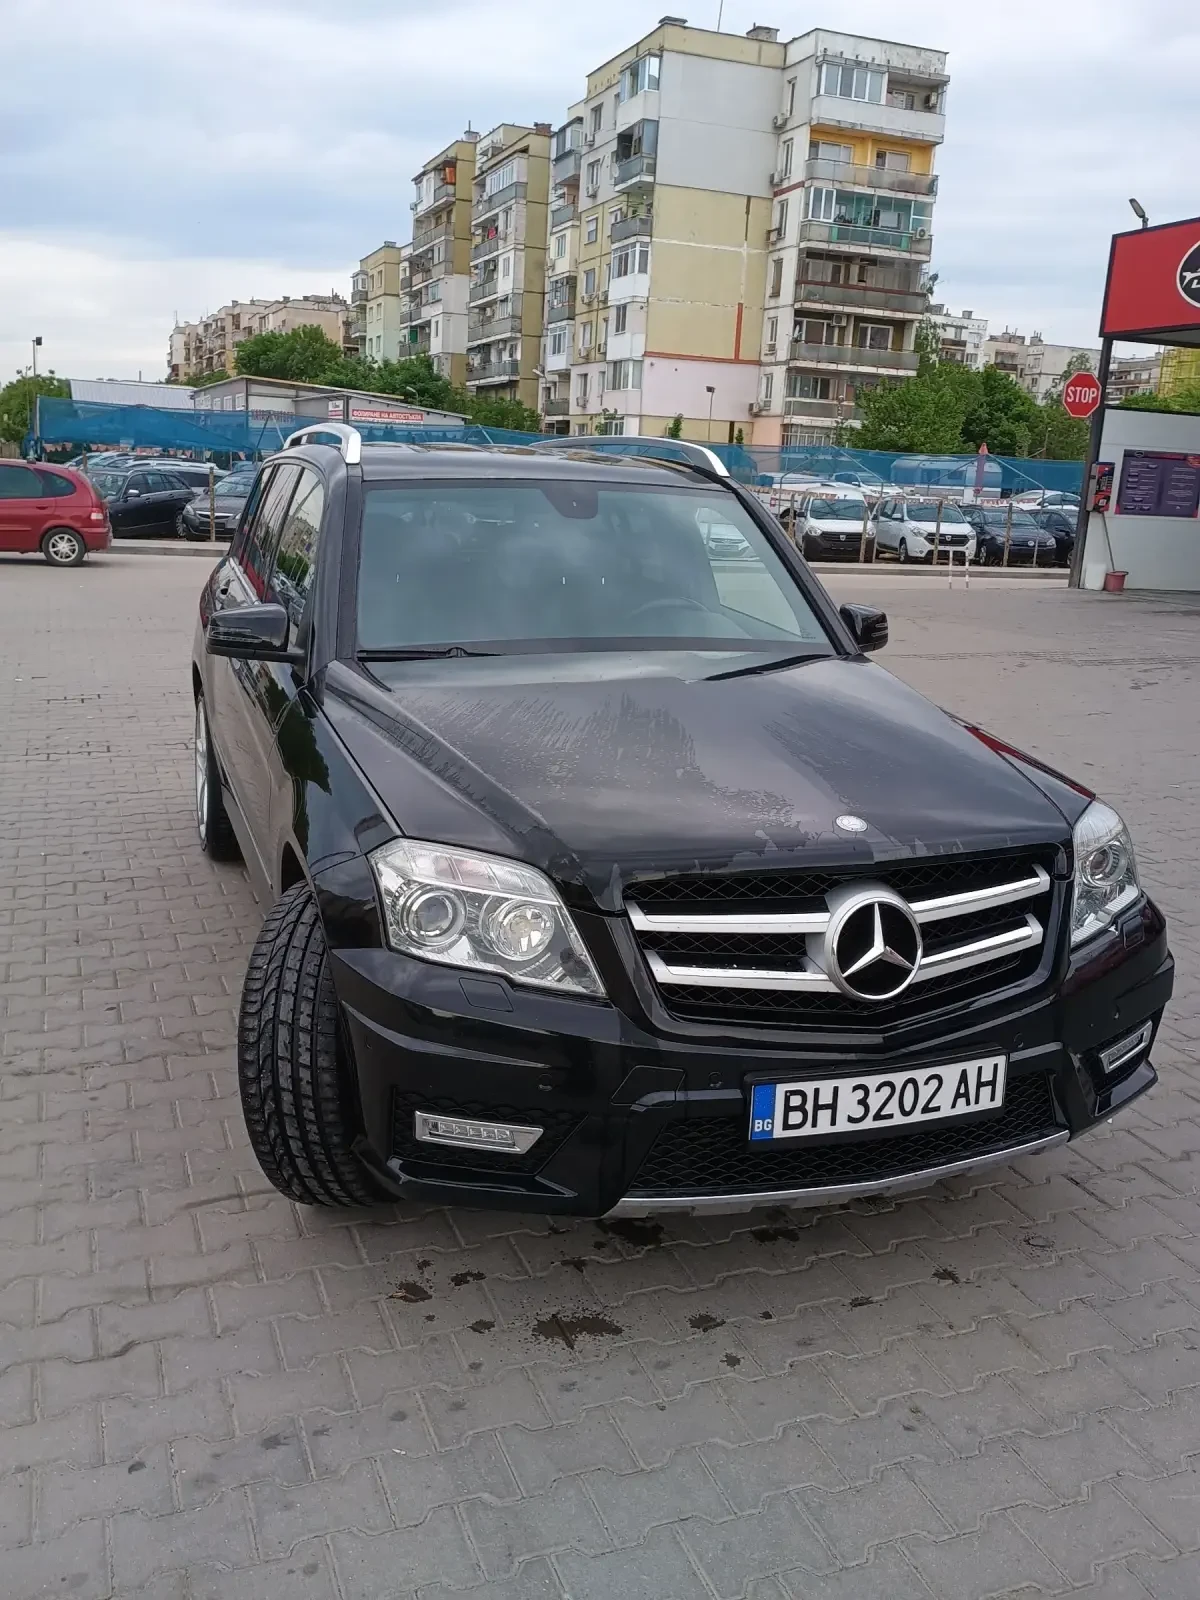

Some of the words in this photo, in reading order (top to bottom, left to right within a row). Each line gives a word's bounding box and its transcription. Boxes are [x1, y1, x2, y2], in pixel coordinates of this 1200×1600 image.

[1066, 386, 1097, 404] STOP
[781, 1085, 839, 1131] BH
[846, 1073, 944, 1124] 3202
[950, 1062, 999, 1110] AH
[754, 1118, 773, 1132] BG
